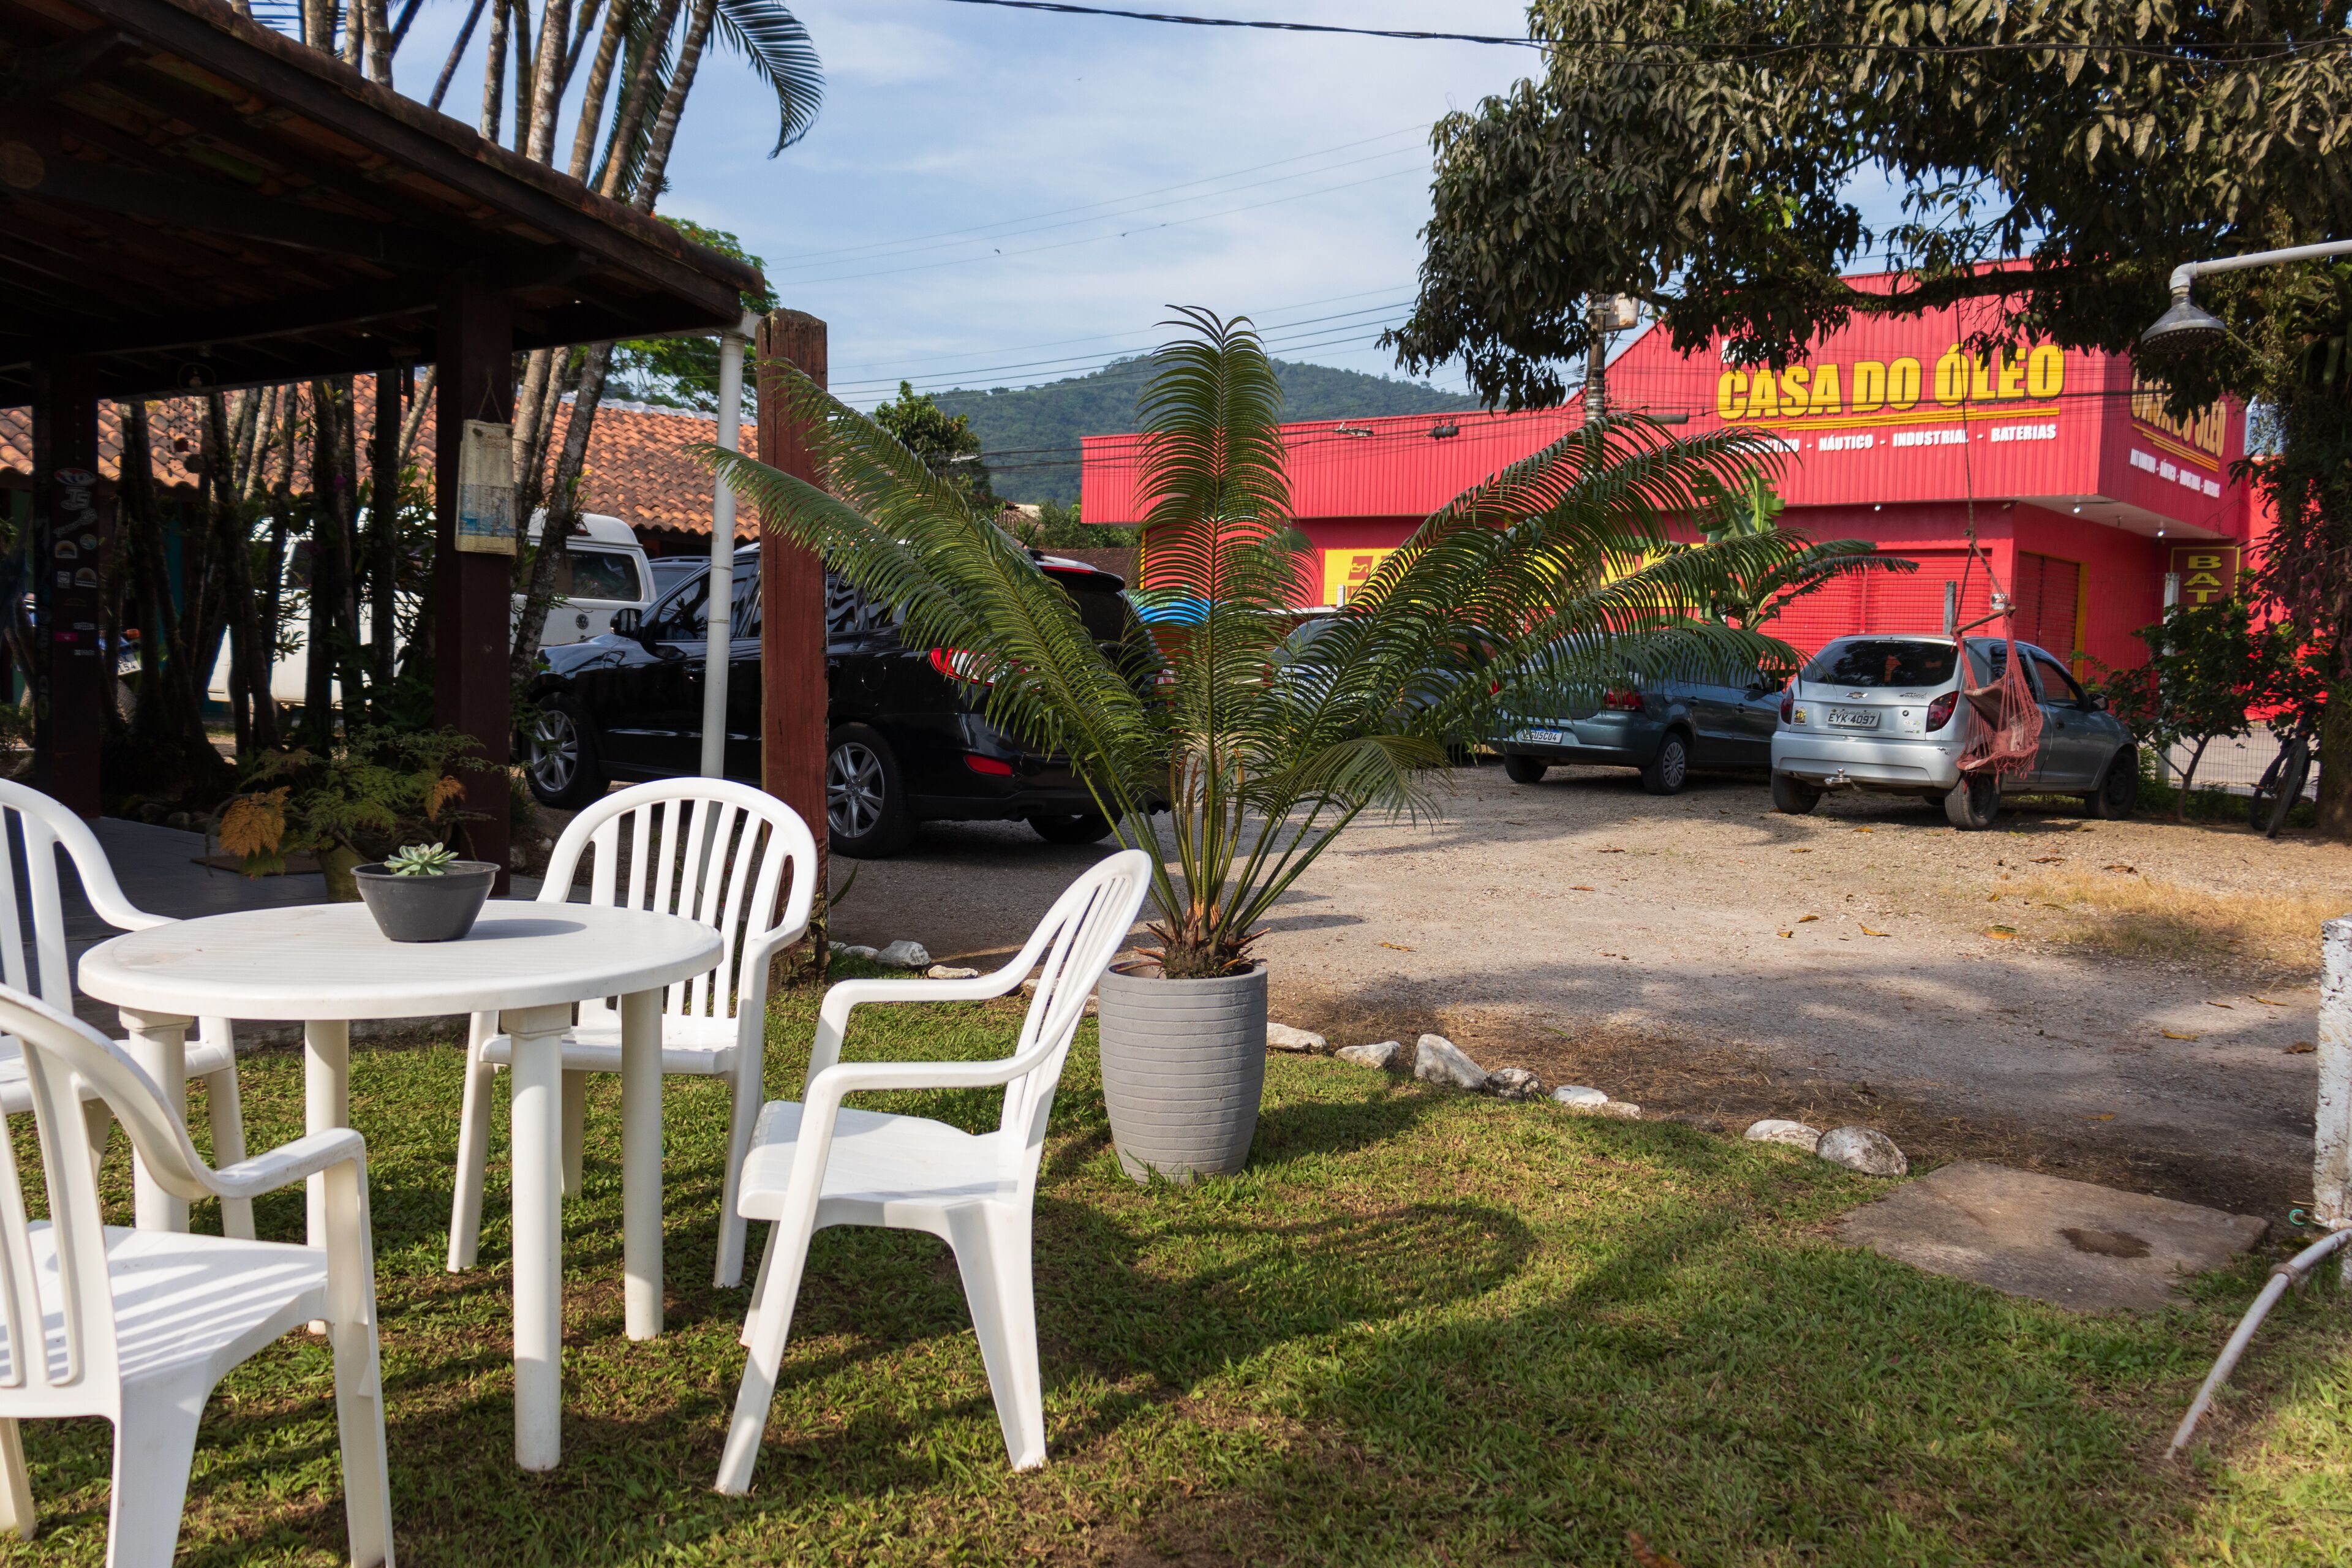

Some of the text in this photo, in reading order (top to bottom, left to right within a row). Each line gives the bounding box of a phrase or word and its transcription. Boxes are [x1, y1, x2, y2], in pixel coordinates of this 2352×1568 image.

[1717, 343, 2065, 420] CASA DO ÓLEO
[1818, 434, 1874, 451] NÁUTICO
[1892, 429, 1969, 447] INDUSTRIAL
[1991, 424, 2057, 442] BATERIAS
